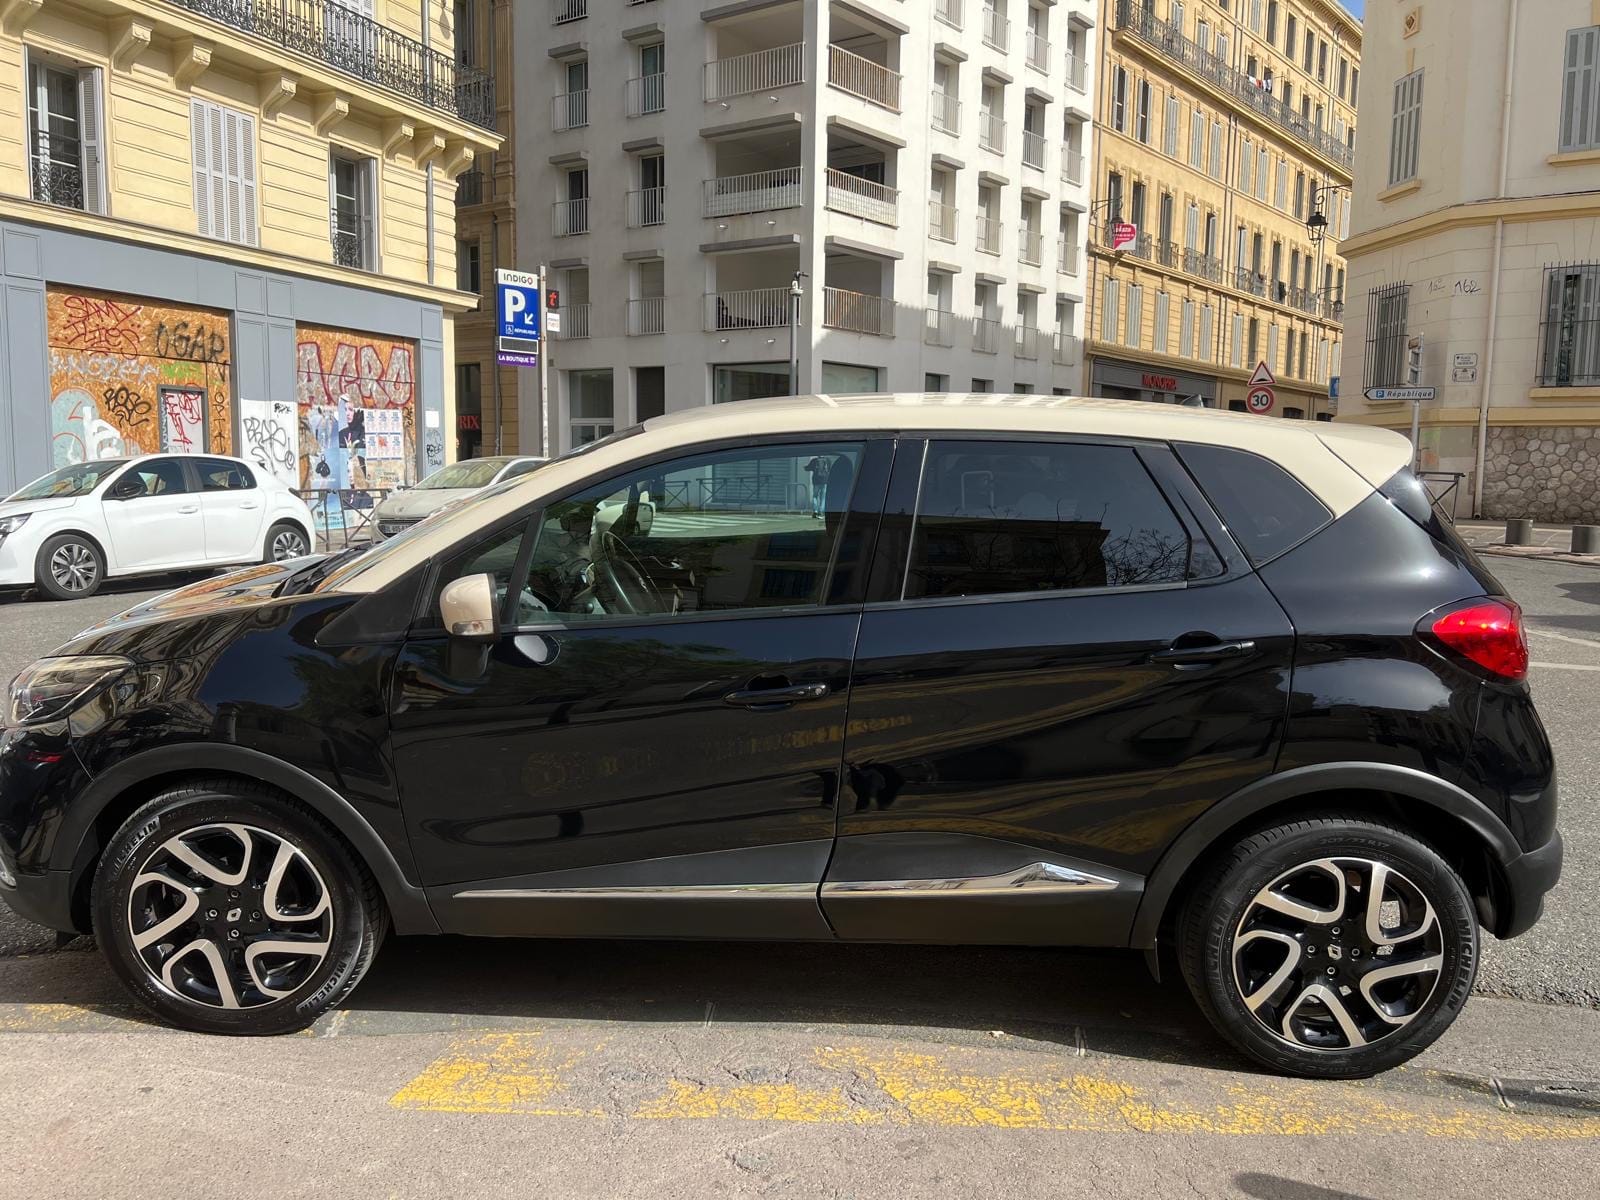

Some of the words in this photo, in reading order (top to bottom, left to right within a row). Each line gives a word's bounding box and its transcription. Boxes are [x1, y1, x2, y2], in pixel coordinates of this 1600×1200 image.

[504, 273, 533, 285] INDIGO
[1455, 279, 1481, 293] 162
[505, 288, 526, 322] P
[1252, 394, 1269, 407] 30
[1387, 390, 1432, 399] République
